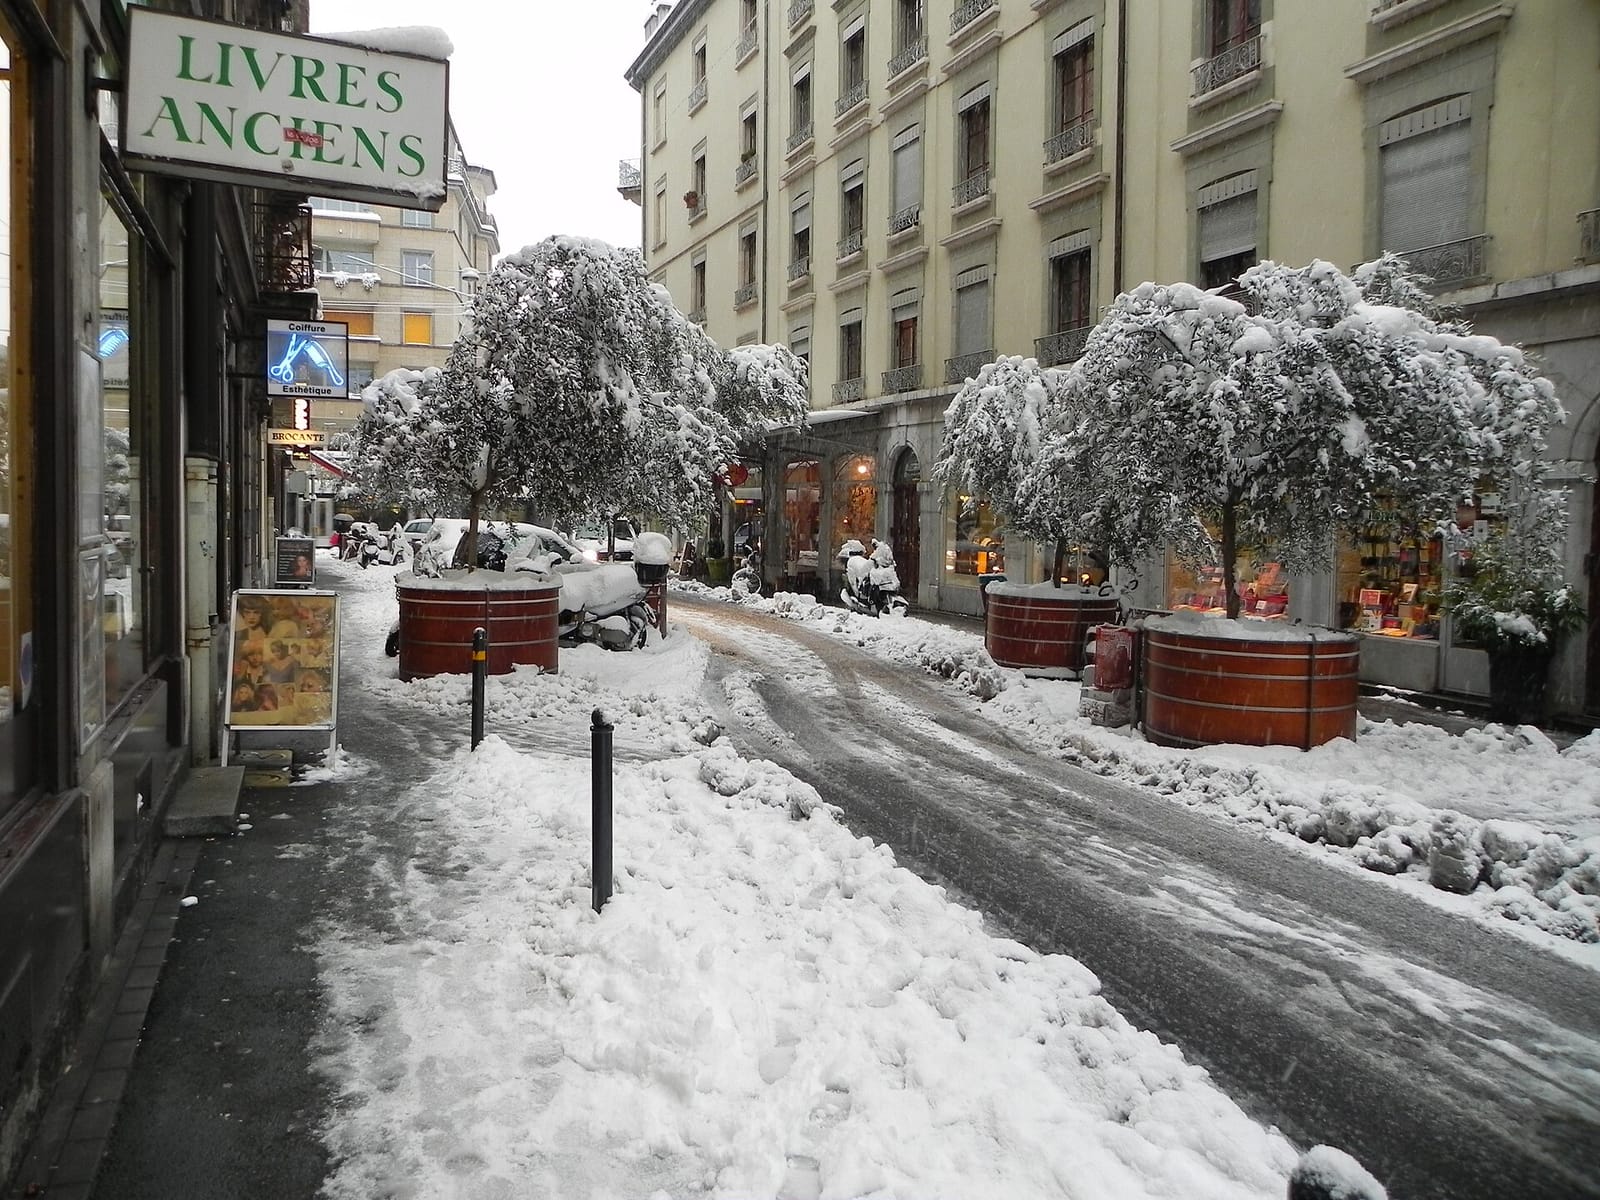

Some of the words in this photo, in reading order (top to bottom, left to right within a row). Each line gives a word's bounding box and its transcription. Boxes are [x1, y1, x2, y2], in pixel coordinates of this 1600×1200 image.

[176, 35, 403, 113] LIVRES
[142, 96, 425, 177] ANCIENS
[288, 323, 326, 332] Coiffure
[282, 385, 332, 395] Esthétique
[272, 432, 325, 441] BROCANTE
